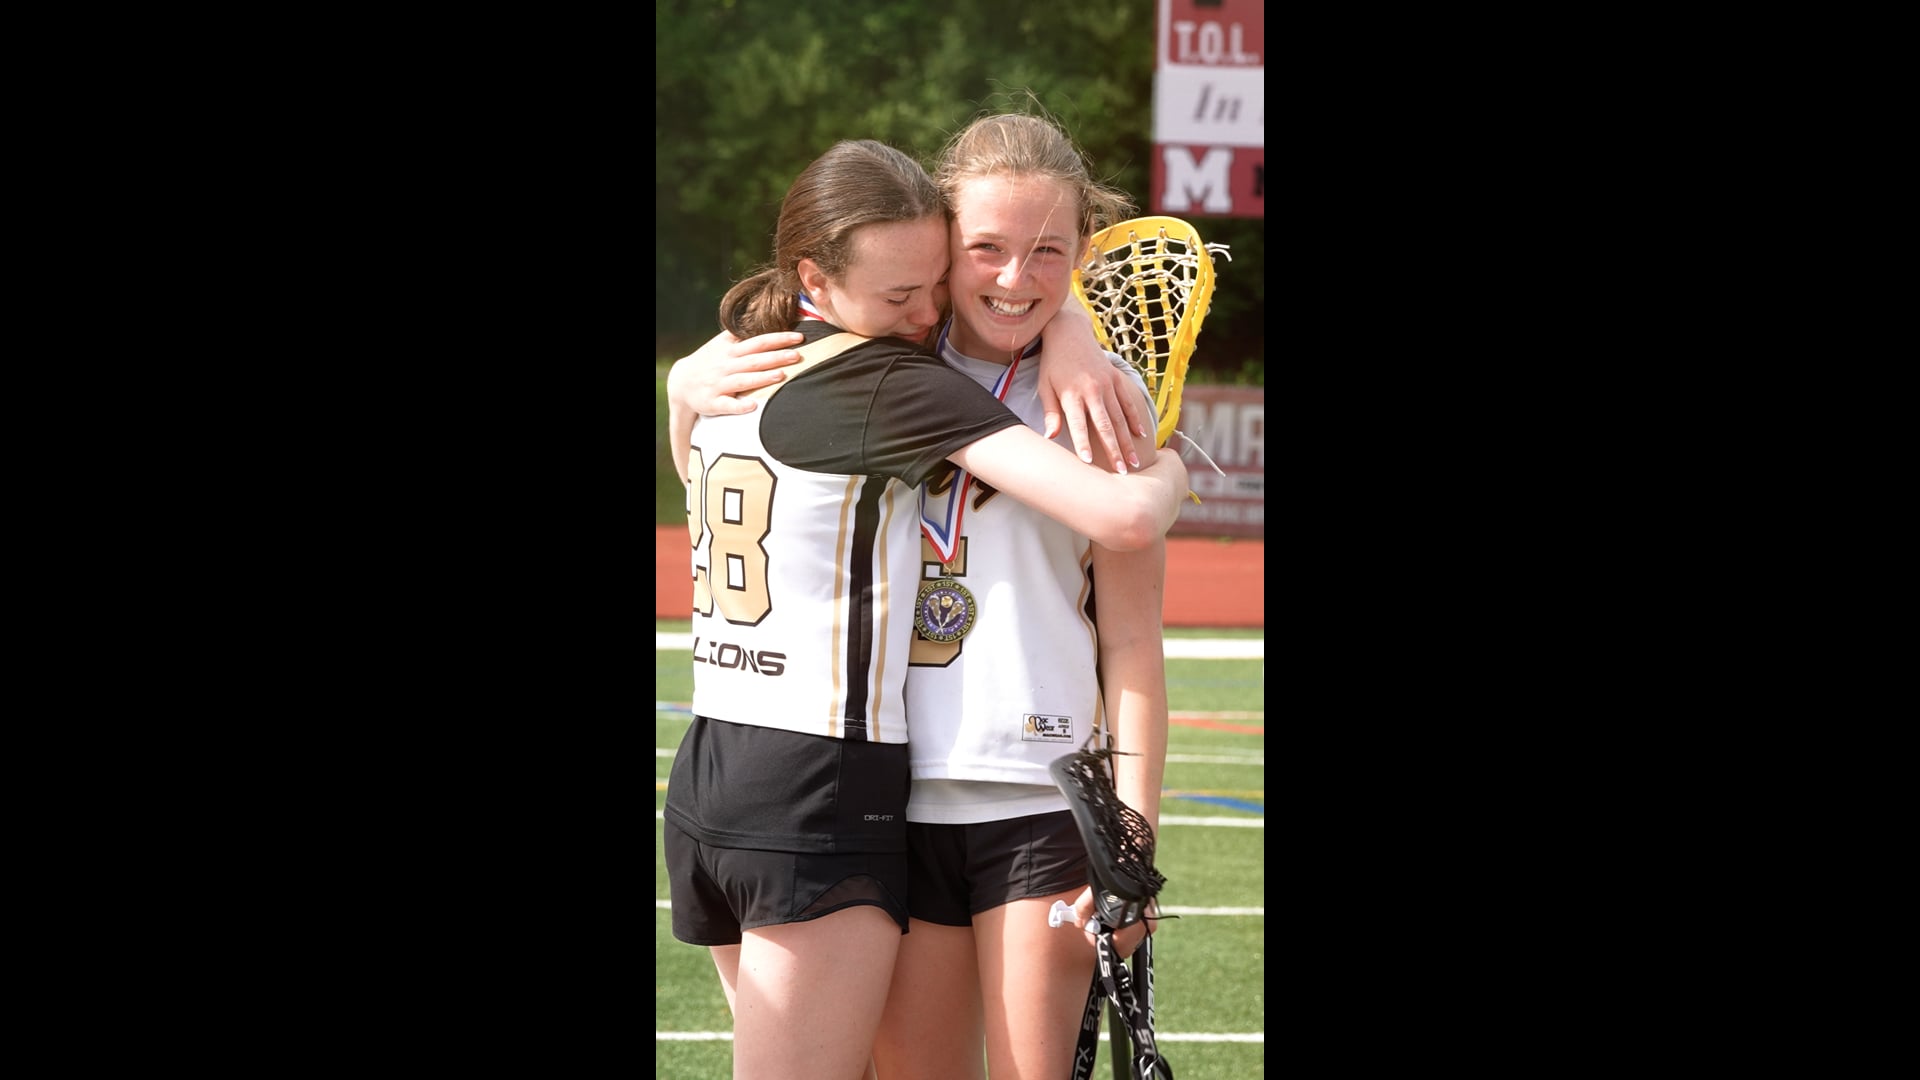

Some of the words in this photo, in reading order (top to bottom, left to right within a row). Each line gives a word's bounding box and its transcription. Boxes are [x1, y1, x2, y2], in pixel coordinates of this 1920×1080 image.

[1194, 83, 1241, 122] In
[1161, 145, 1234, 213] M
[693, 636, 787, 677] LIONS
[1096, 932, 1111, 977] STX
